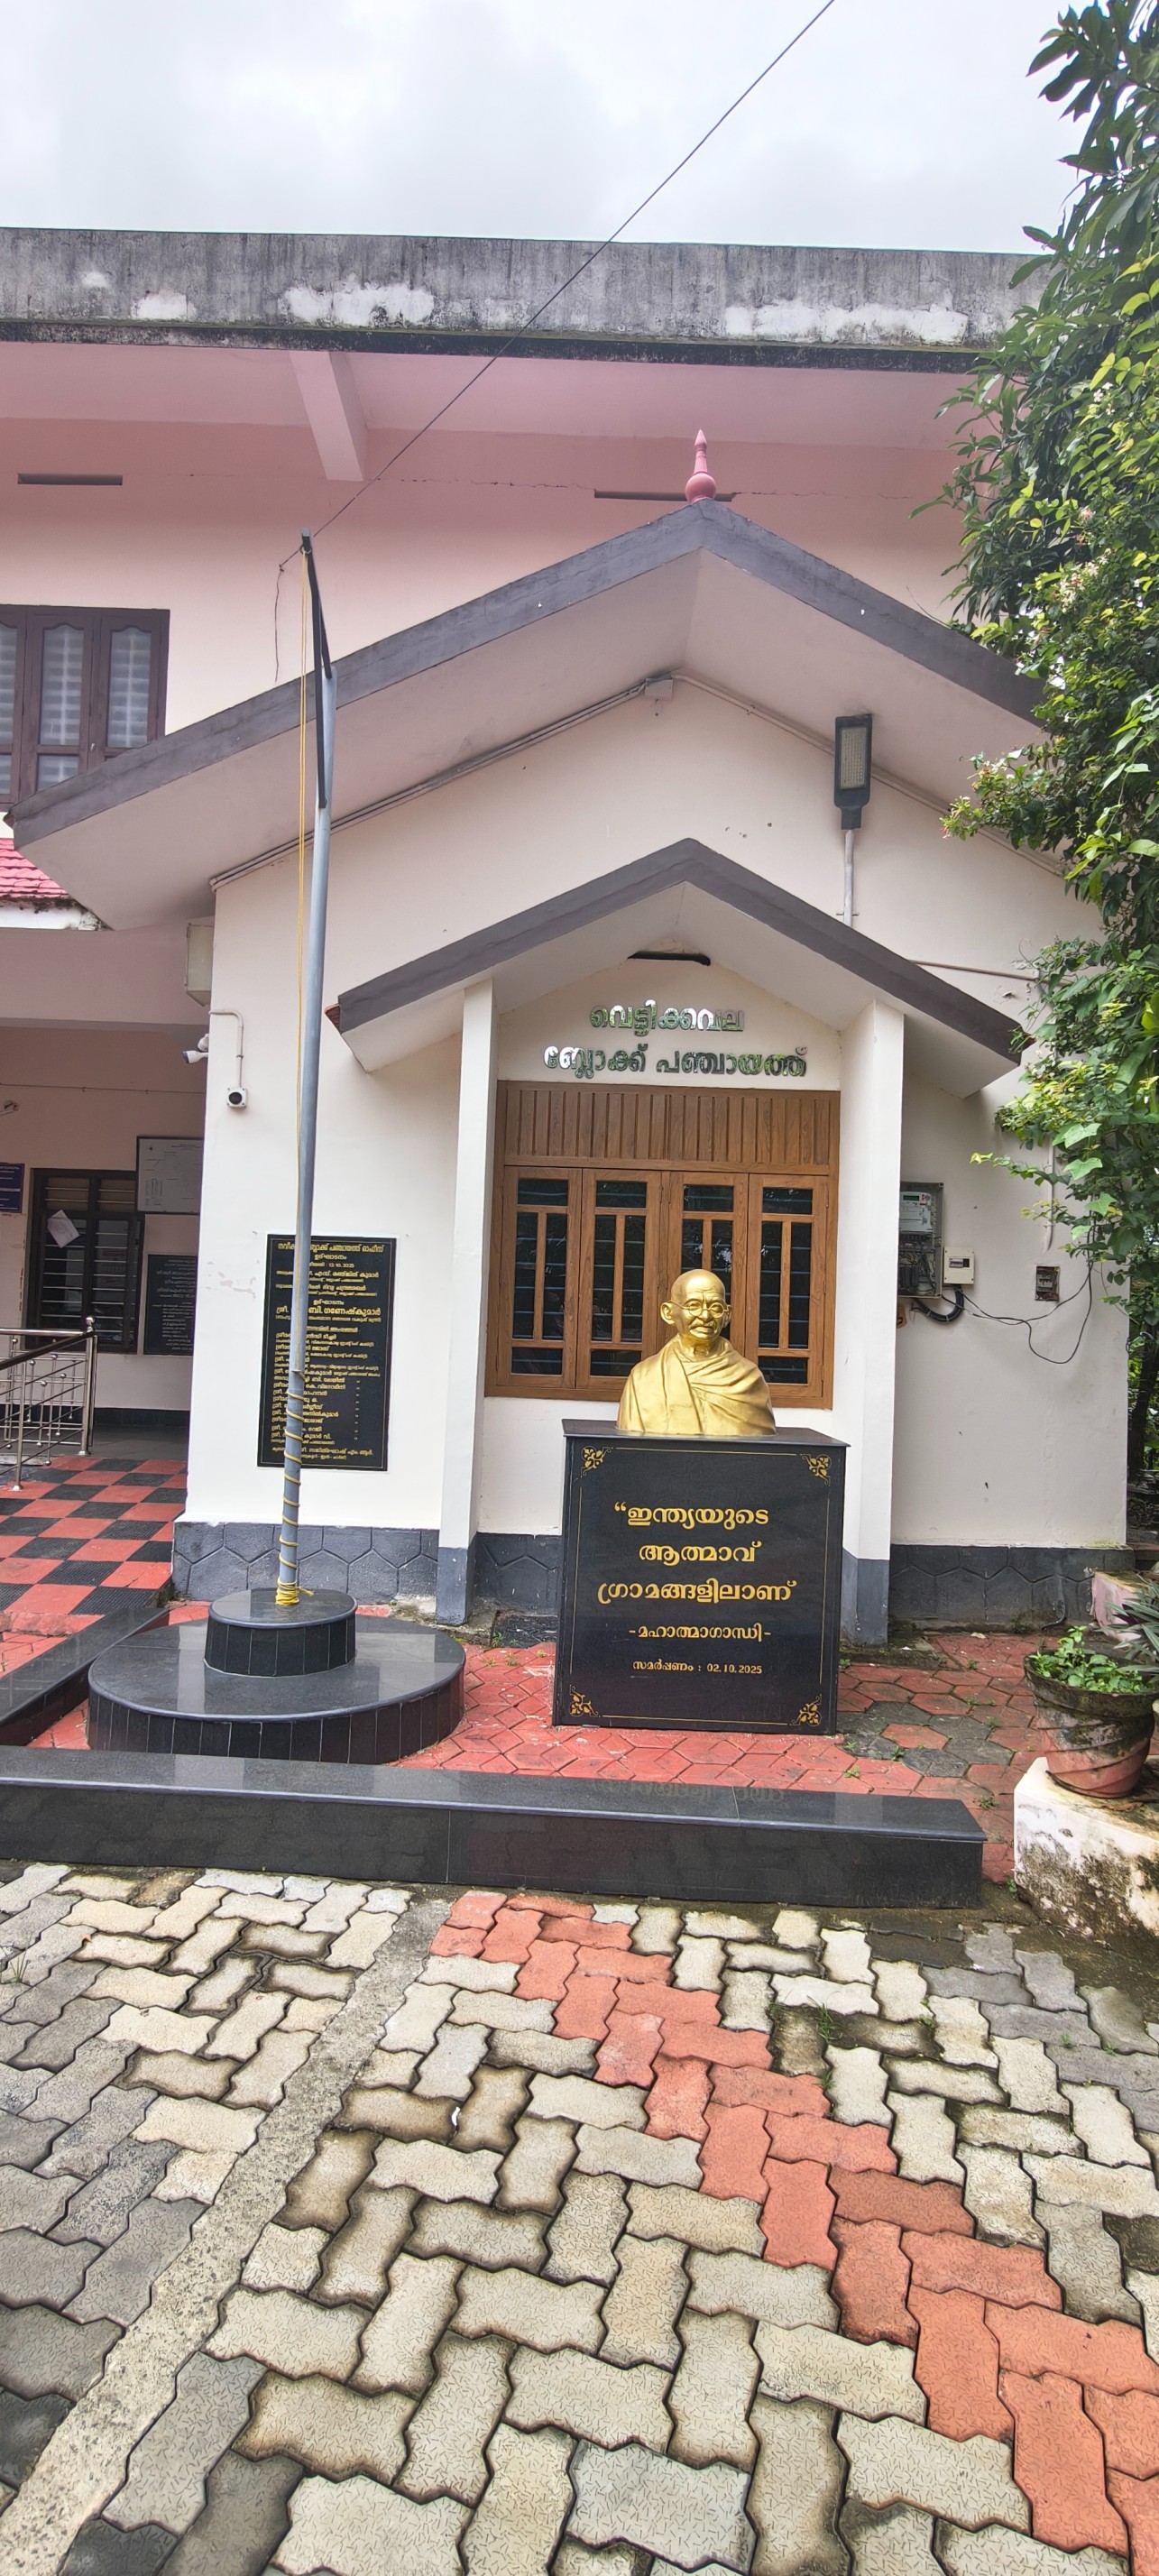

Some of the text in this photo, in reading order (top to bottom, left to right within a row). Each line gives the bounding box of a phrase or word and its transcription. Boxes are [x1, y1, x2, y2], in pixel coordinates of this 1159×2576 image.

[590, 999, 744, 1036] വെട്ടിക്കവല
[544, 1043, 808, 1079] ബ്ലോക്ക് പഞ്ചായത്ത്
[614, 1502, 768, 1531] “ഇന്ത്യയുടെ
[639, 1541, 762, 1566] ആത്മാവ്
[597, 1578, 797, 1605] ഗ്രാമങ്ങളിലാണ്
[632, 1659, 694, 1671] സമർപ്പണം
